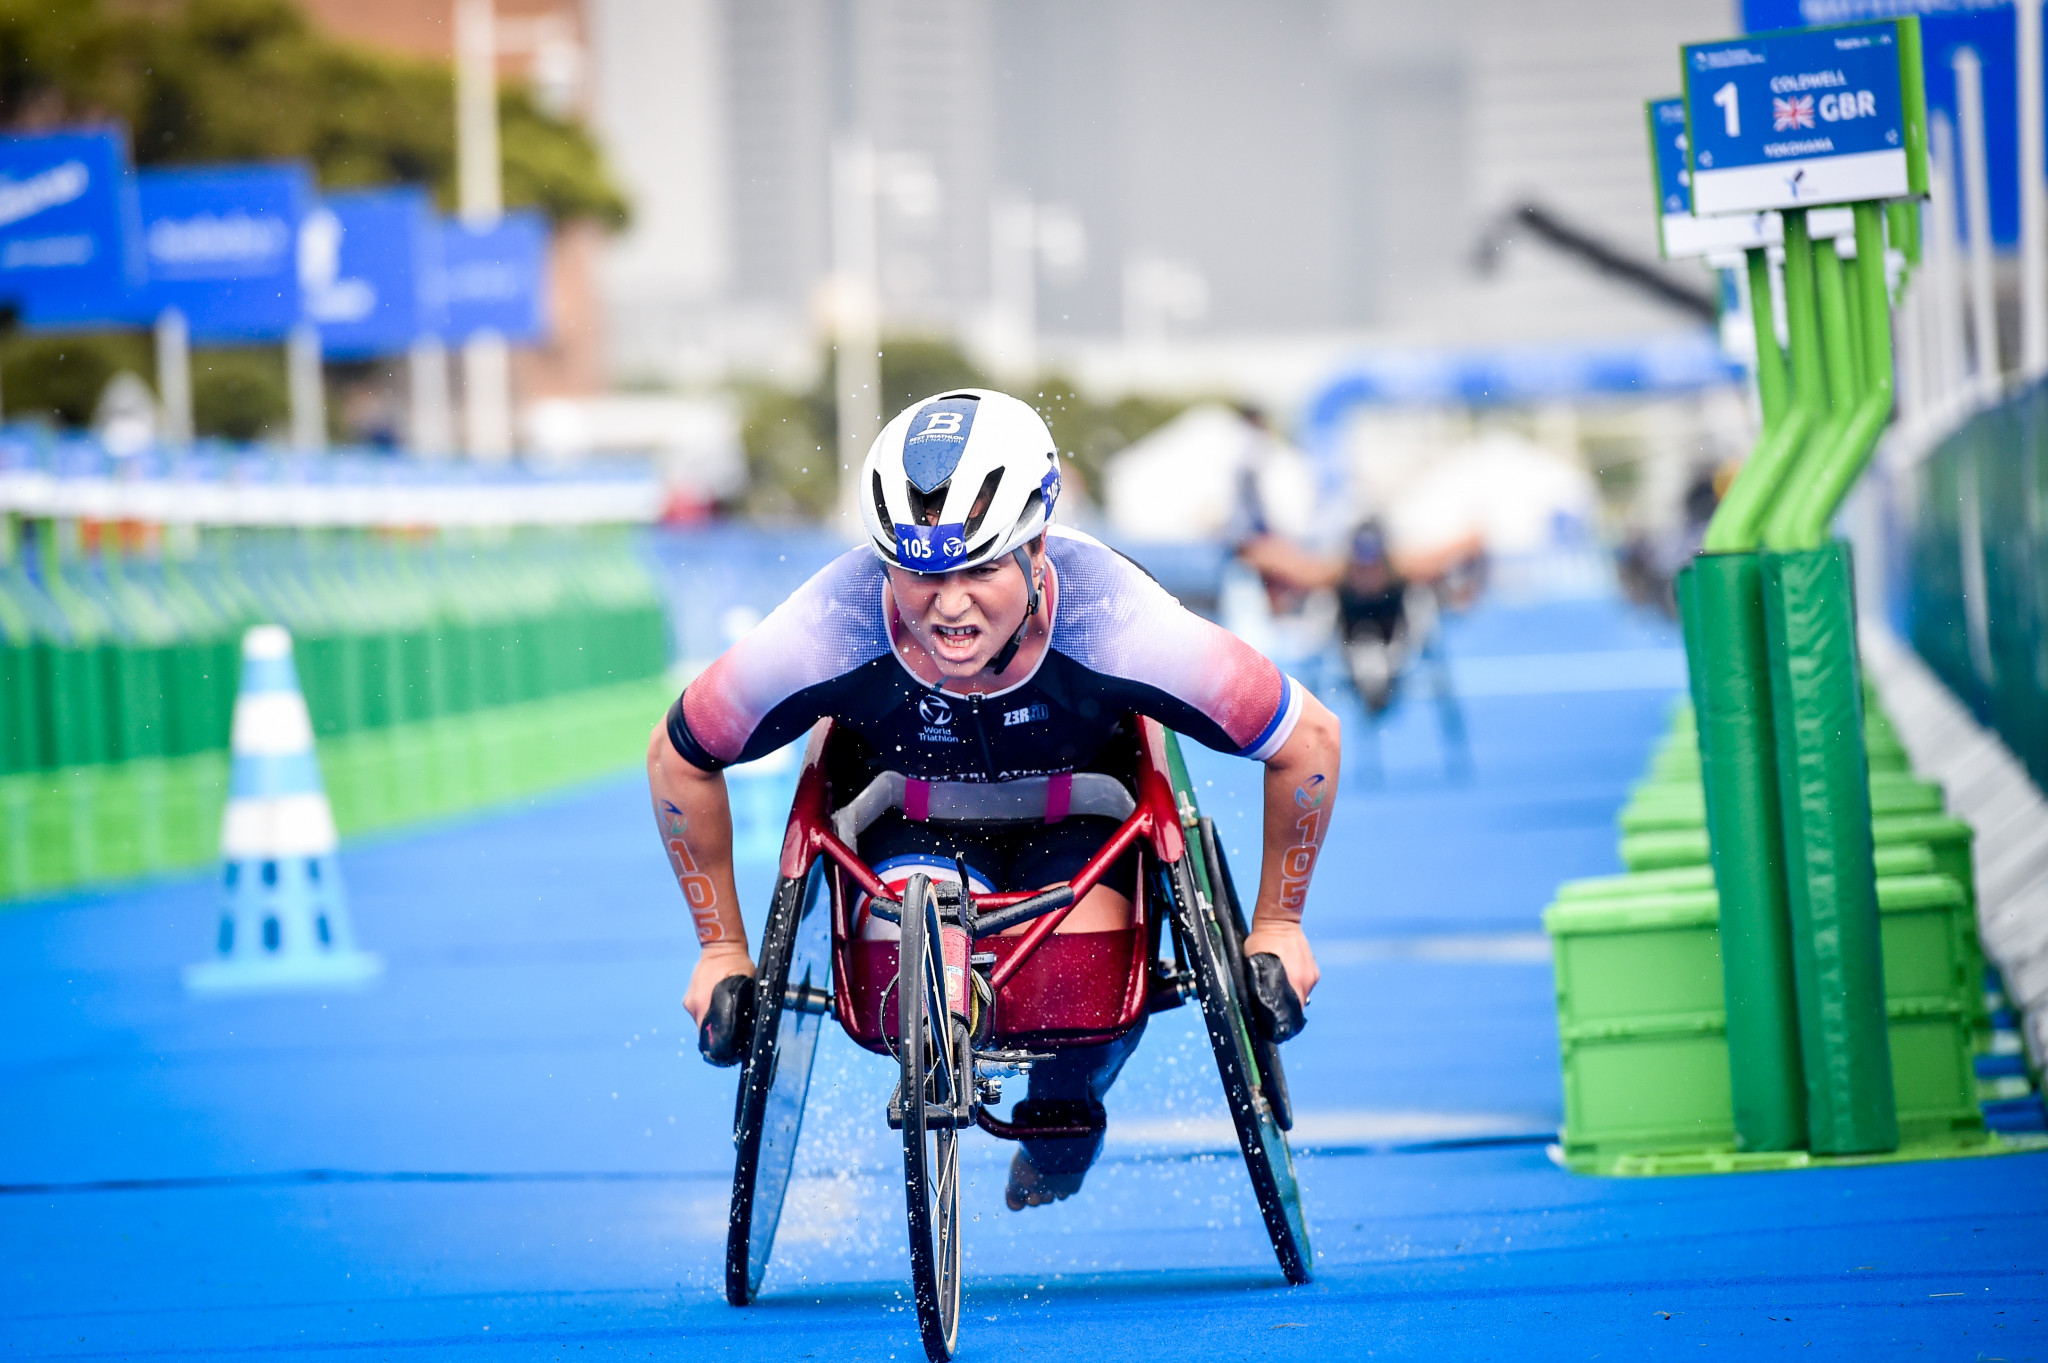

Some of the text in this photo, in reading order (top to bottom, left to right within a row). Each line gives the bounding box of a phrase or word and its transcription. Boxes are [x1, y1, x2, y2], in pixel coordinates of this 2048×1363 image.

[1713, 81, 1877, 138] 1 GBR
[902, 538, 932, 559] 105
[918, 733, 959, 743] Triathlon
[923, 726, 952, 735] World
[1280, 808, 1321, 911] 105
[669, 838, 725, 942] 105
